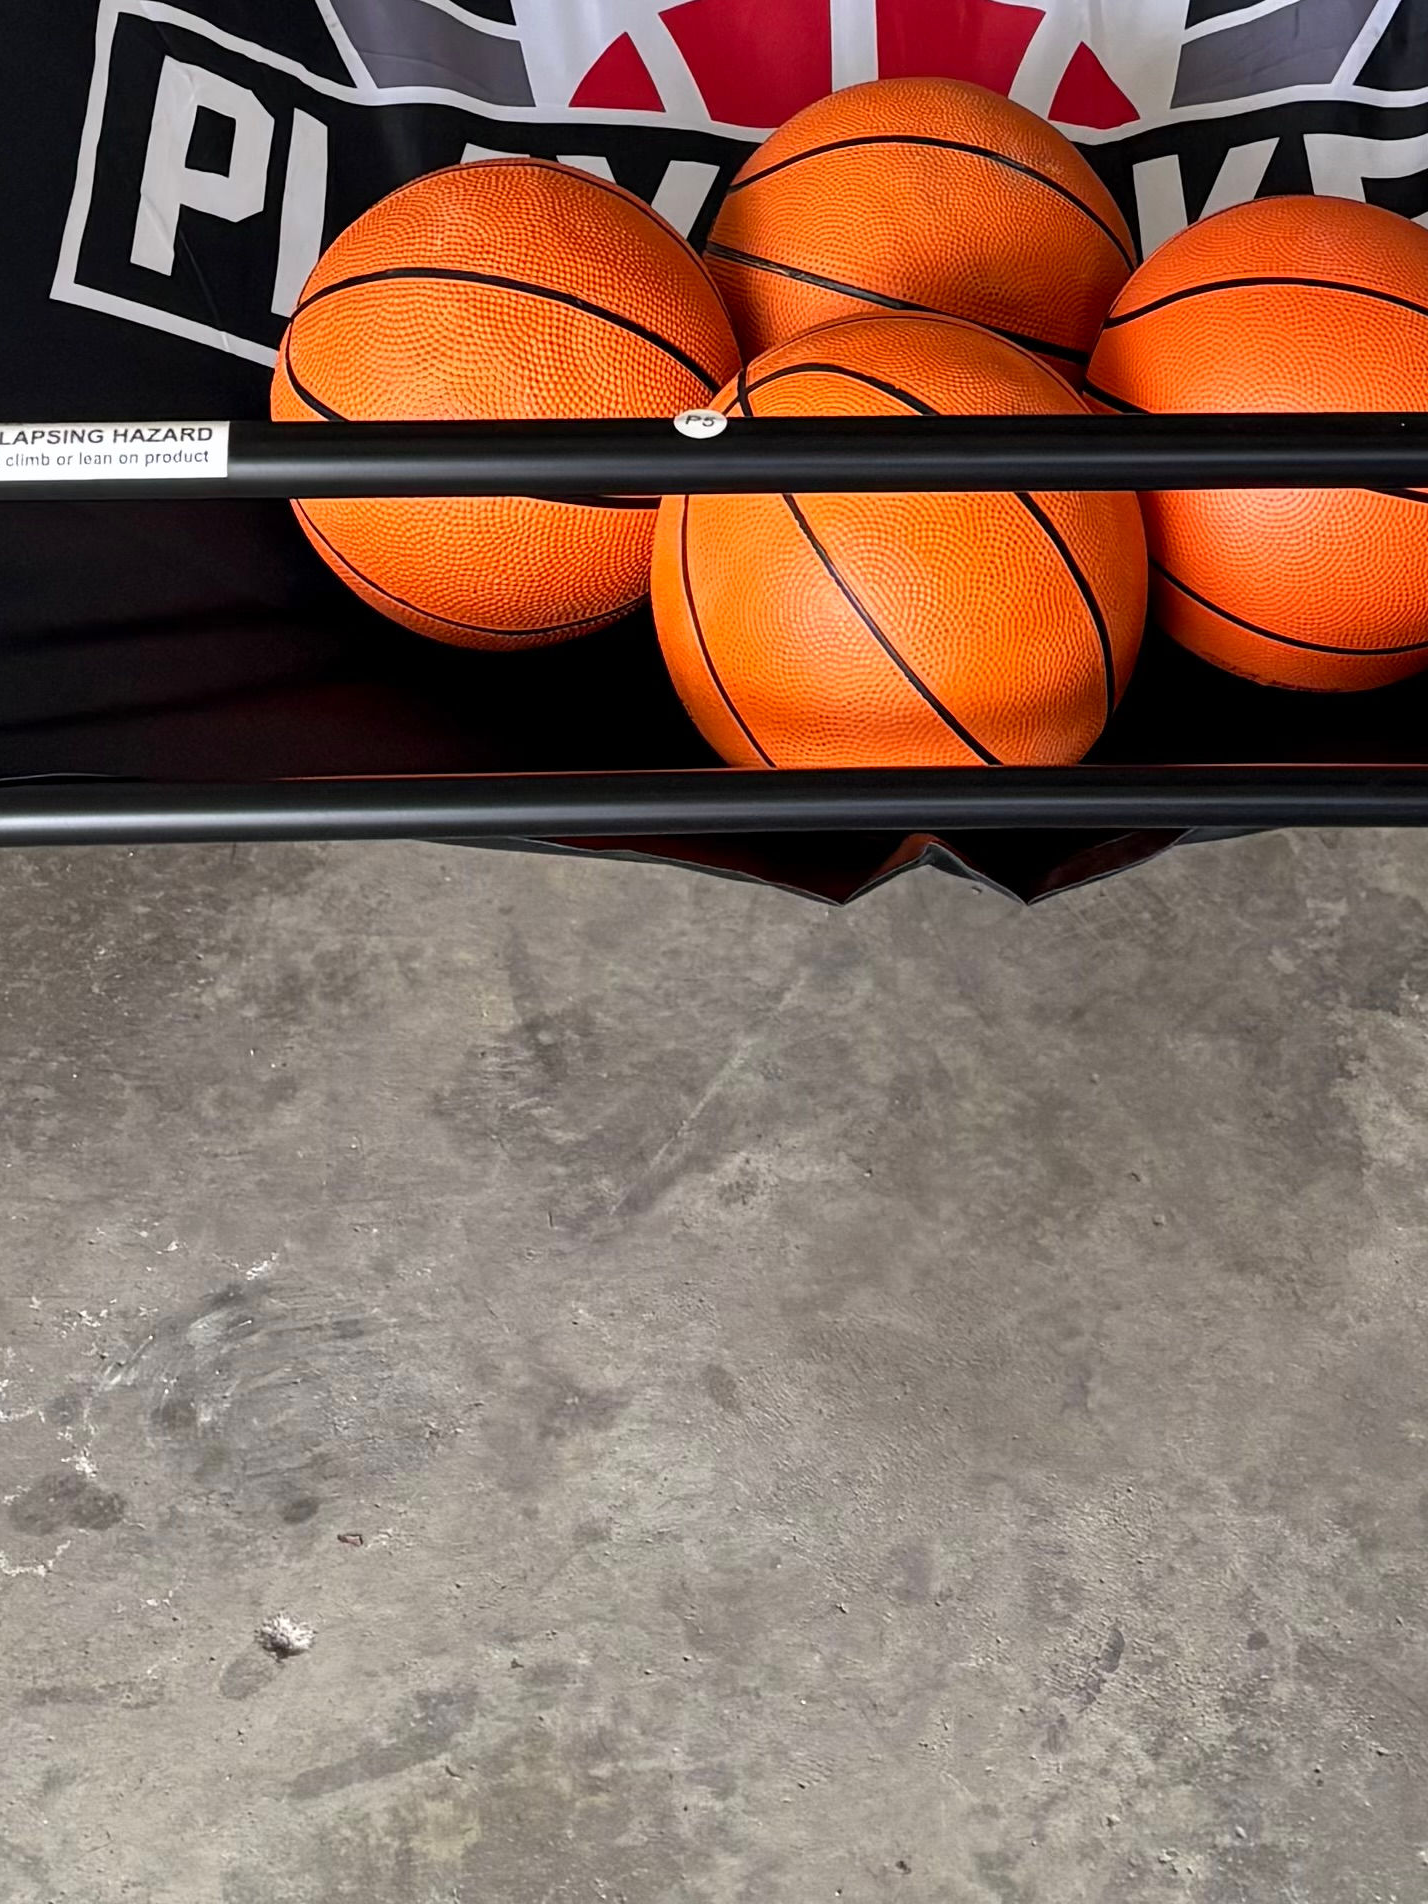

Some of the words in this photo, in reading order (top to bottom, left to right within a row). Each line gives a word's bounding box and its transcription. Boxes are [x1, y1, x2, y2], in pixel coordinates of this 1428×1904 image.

[684, 414, 717, 428] P5
[112, 427, 214, 443] HAZARD
[5, 452, 51, 467] climb
[56, 454, 74, 466] or
[78, 451, 113, 465] lean
[118, 453, 139, 465] on
[144, 449, 209, 468] product
